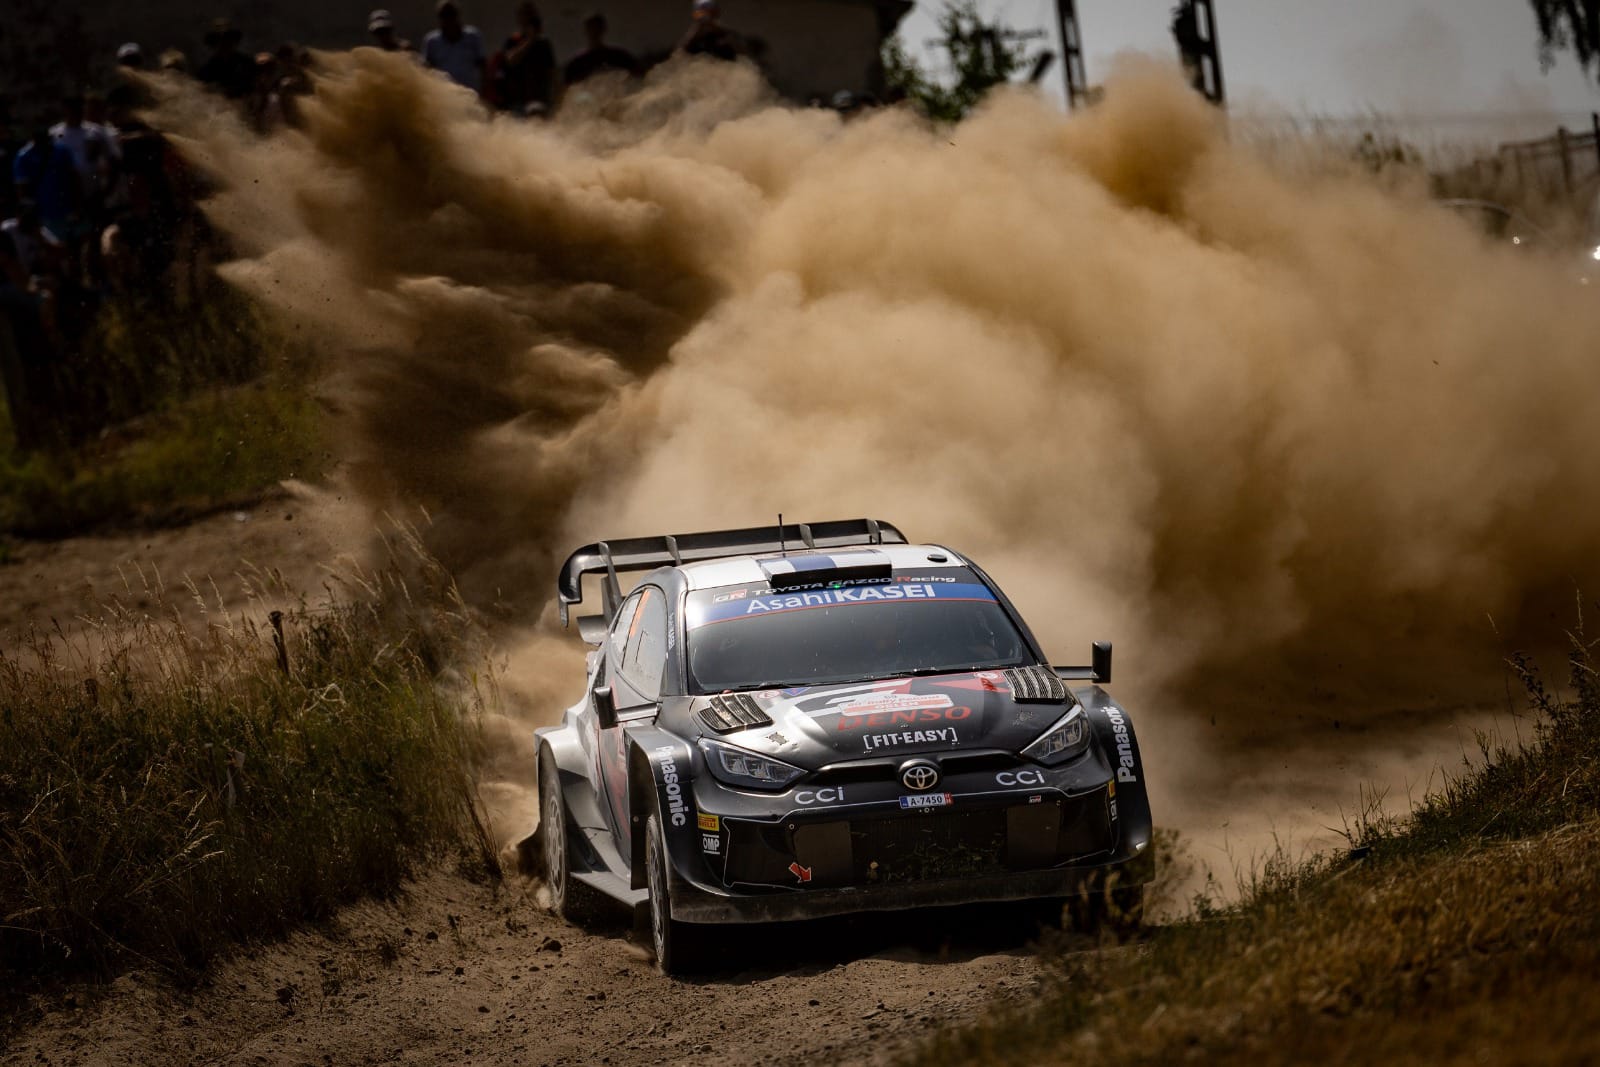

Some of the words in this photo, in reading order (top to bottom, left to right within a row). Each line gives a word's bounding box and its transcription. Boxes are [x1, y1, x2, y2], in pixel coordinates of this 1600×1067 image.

[752, 582, 823, 595] TOYOTA
[828, 576, 892, 587] GAZOO
[896, 575, 956, 583] Racing
[837, 705, 972, 731] DENSO
[1101, 706, 1137, 783] Panasonic
[656, 746, 689, 827] Panasonic
[703, 837, 720, 851] OMP
